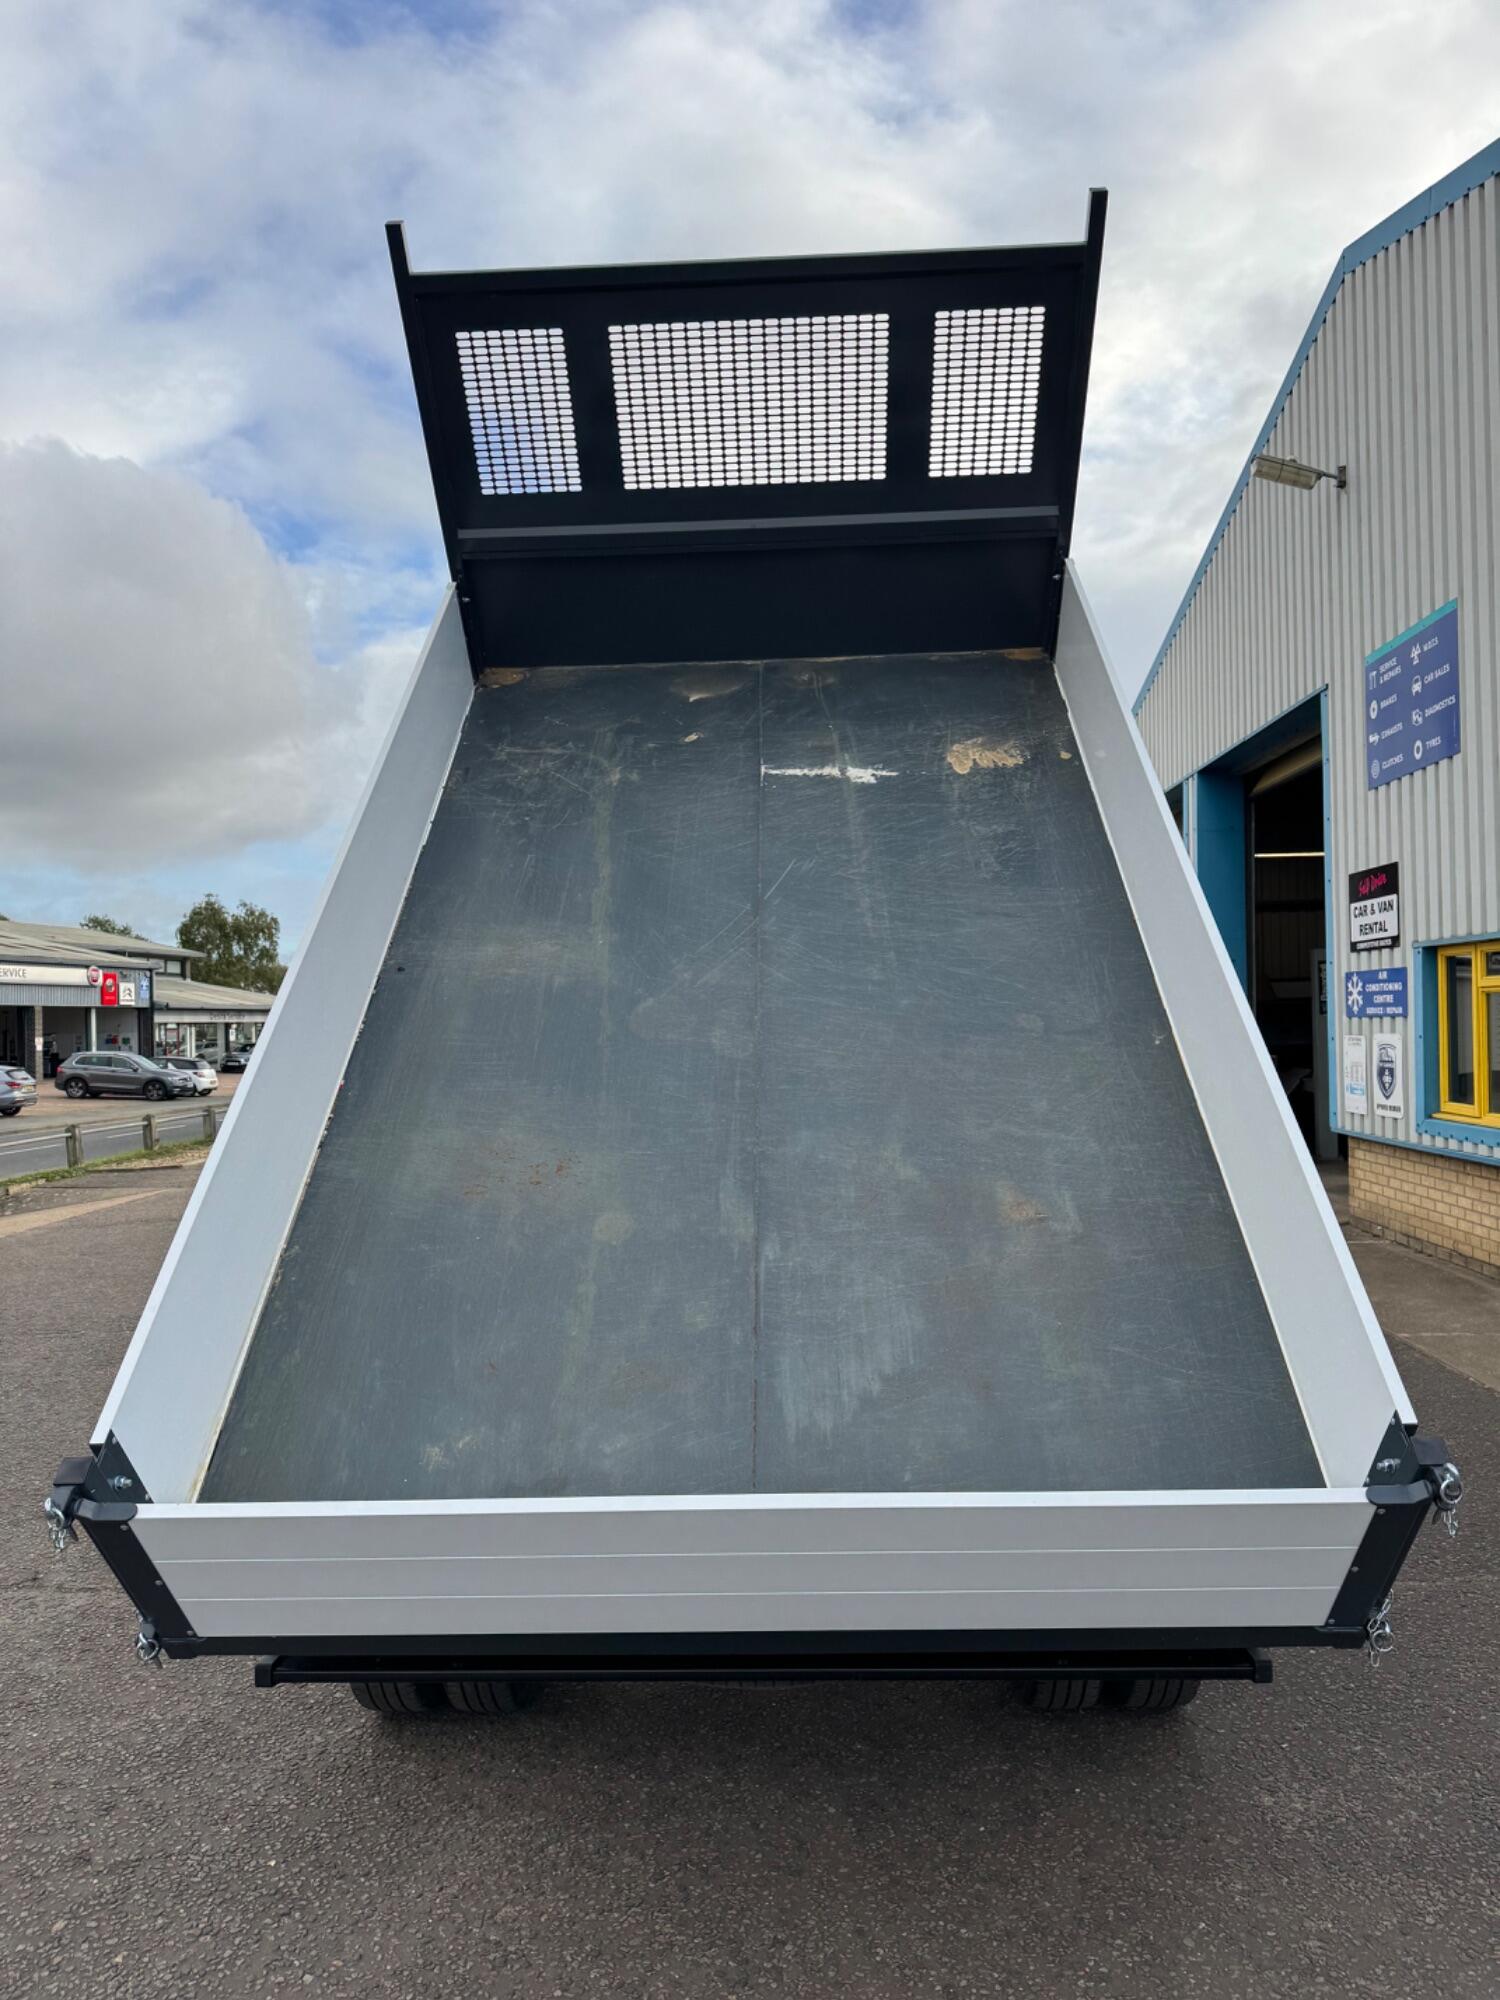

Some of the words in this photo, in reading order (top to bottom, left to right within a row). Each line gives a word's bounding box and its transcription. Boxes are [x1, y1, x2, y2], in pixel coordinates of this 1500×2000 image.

[1424, 671, 1434, 685] CAR
[1435, 663, 1450, 679] SALES
[1425, 694, 1456, 717] DIAGNOSTICS
[1425, 735, 1441, 750] TYRES
[1353, 904, 1368, 919] CAR
[1370, 903, 1376, 916] &
[1377, 899, 1394, 914] VAN
[1359, 920, 1389, 936] RENTAL
[1378, 970, 1388, 980] AIR
[1365, 982, 1403, 992] CONDITIONING
